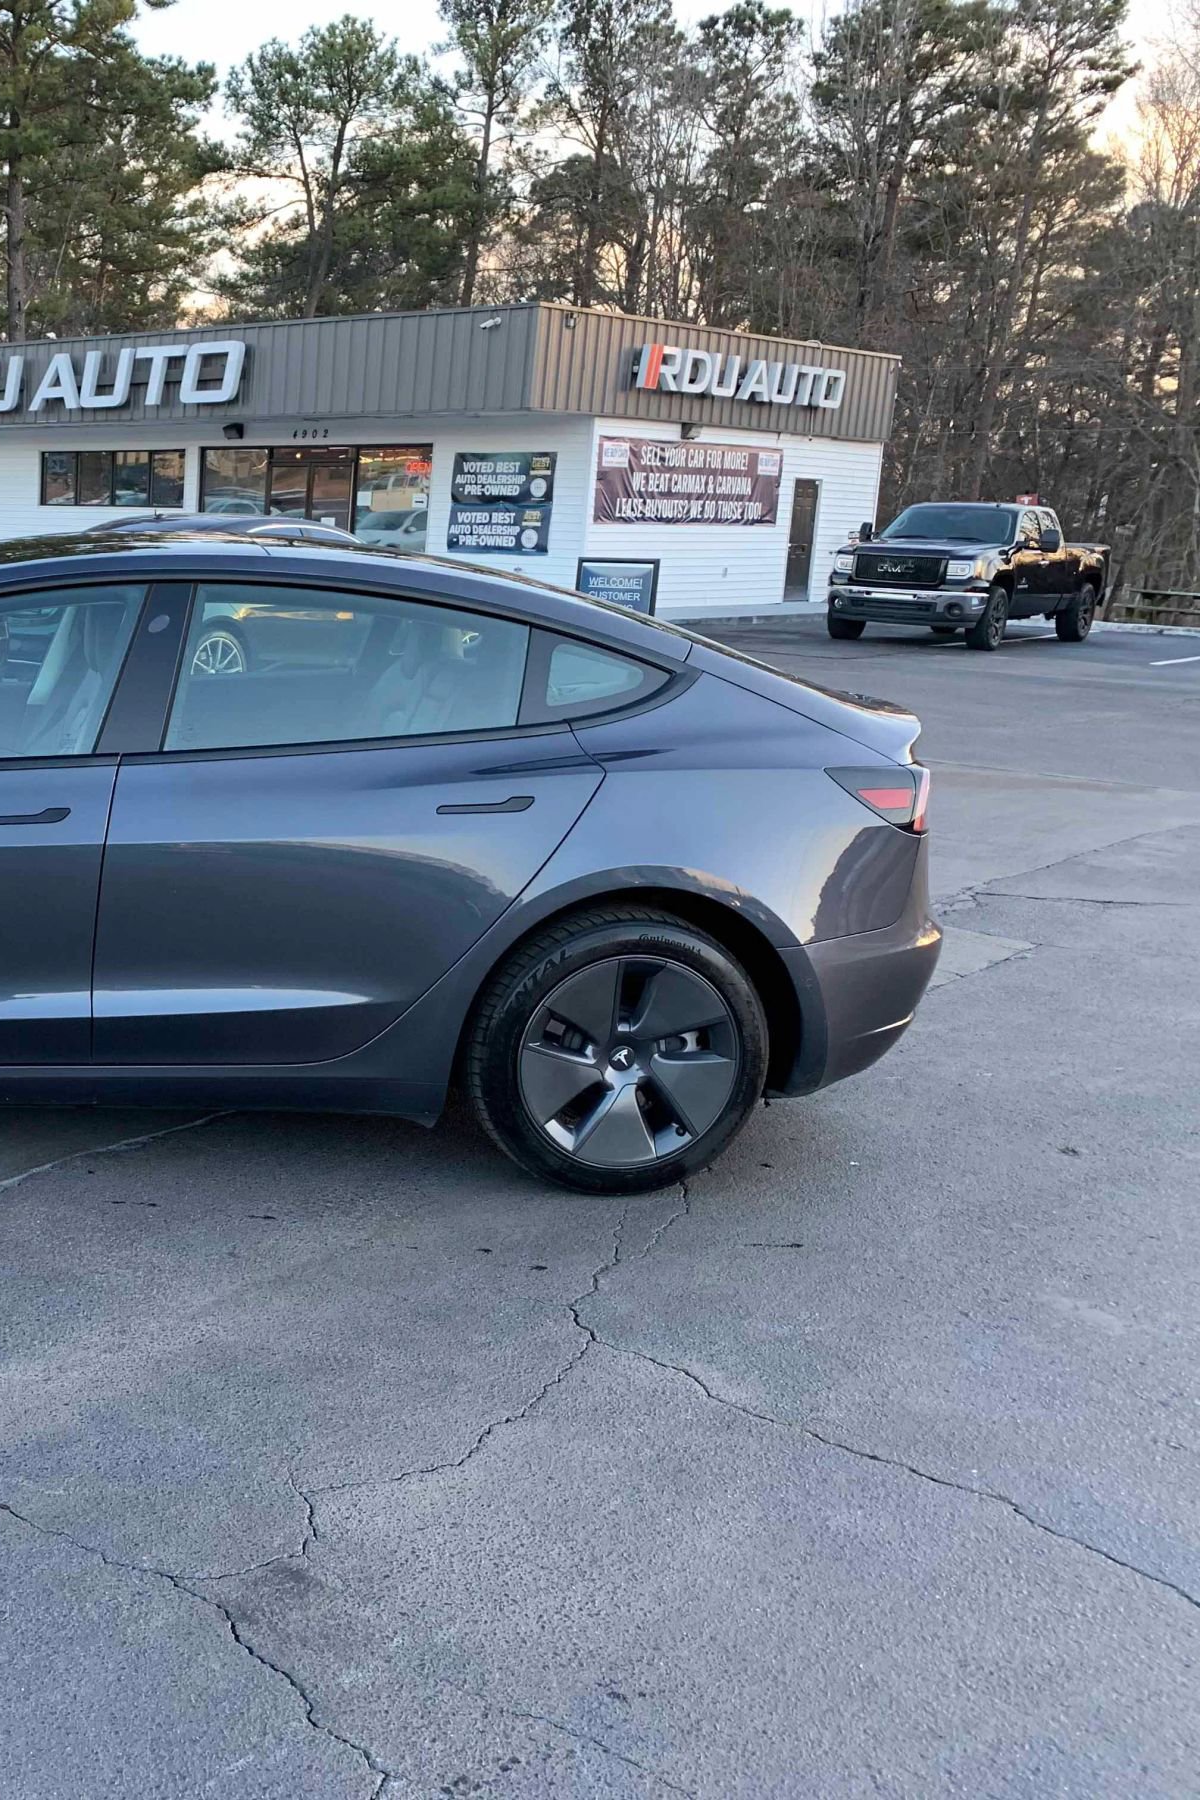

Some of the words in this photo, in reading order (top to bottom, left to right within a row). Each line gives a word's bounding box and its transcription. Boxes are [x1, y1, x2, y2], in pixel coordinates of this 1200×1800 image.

[28, 340, 246, 411] AUTO
[657, 345, 741, 398] RDU
[734, 359, 846, 409] AUTO
[641, 446, 662, 466] SELL
[664, 448, 687, 467] YOUR
[688, 449, 705, 468] CAR
[705, 450, 723, 469] FOR
[723, 451, 749, 470] MORE!
[463, 462, 494, 473] VOTED
[496, 462, 521, 473] BEST
[455, 474, 477, 484] AUTO
[477, 475, 527, 485] DEALERSHIP
[633, 471, 647, 492] WE
[648, 472, 671, 492] BEAT
[671, 474, 707, 494] CARMAX
[707, 475, 714, 494] &
[715, 476, 752, 495] CARVANA
[464, 485, 520, 496] PRE-OWNED
[615, 498, 644, 517] LEASE
[645, 499, 688, 518] BUYOUTS?
[689, 500, 704, 519] WE
[704, 501, 716, 519] DO
[717, 501, 743, 519] THOSE
[743, 502, 763, 520] TOO!
[457, 512, 489, 523] VOTED
[491, 512, 516, 524] BEST
[449, 525, 471, 535] AUTO
[472, 525, 521, 536] DEALERSHIP
[459, 535, 516, 547] PRE-OWNED
[588, 576, 643, 588] WELCOME!
